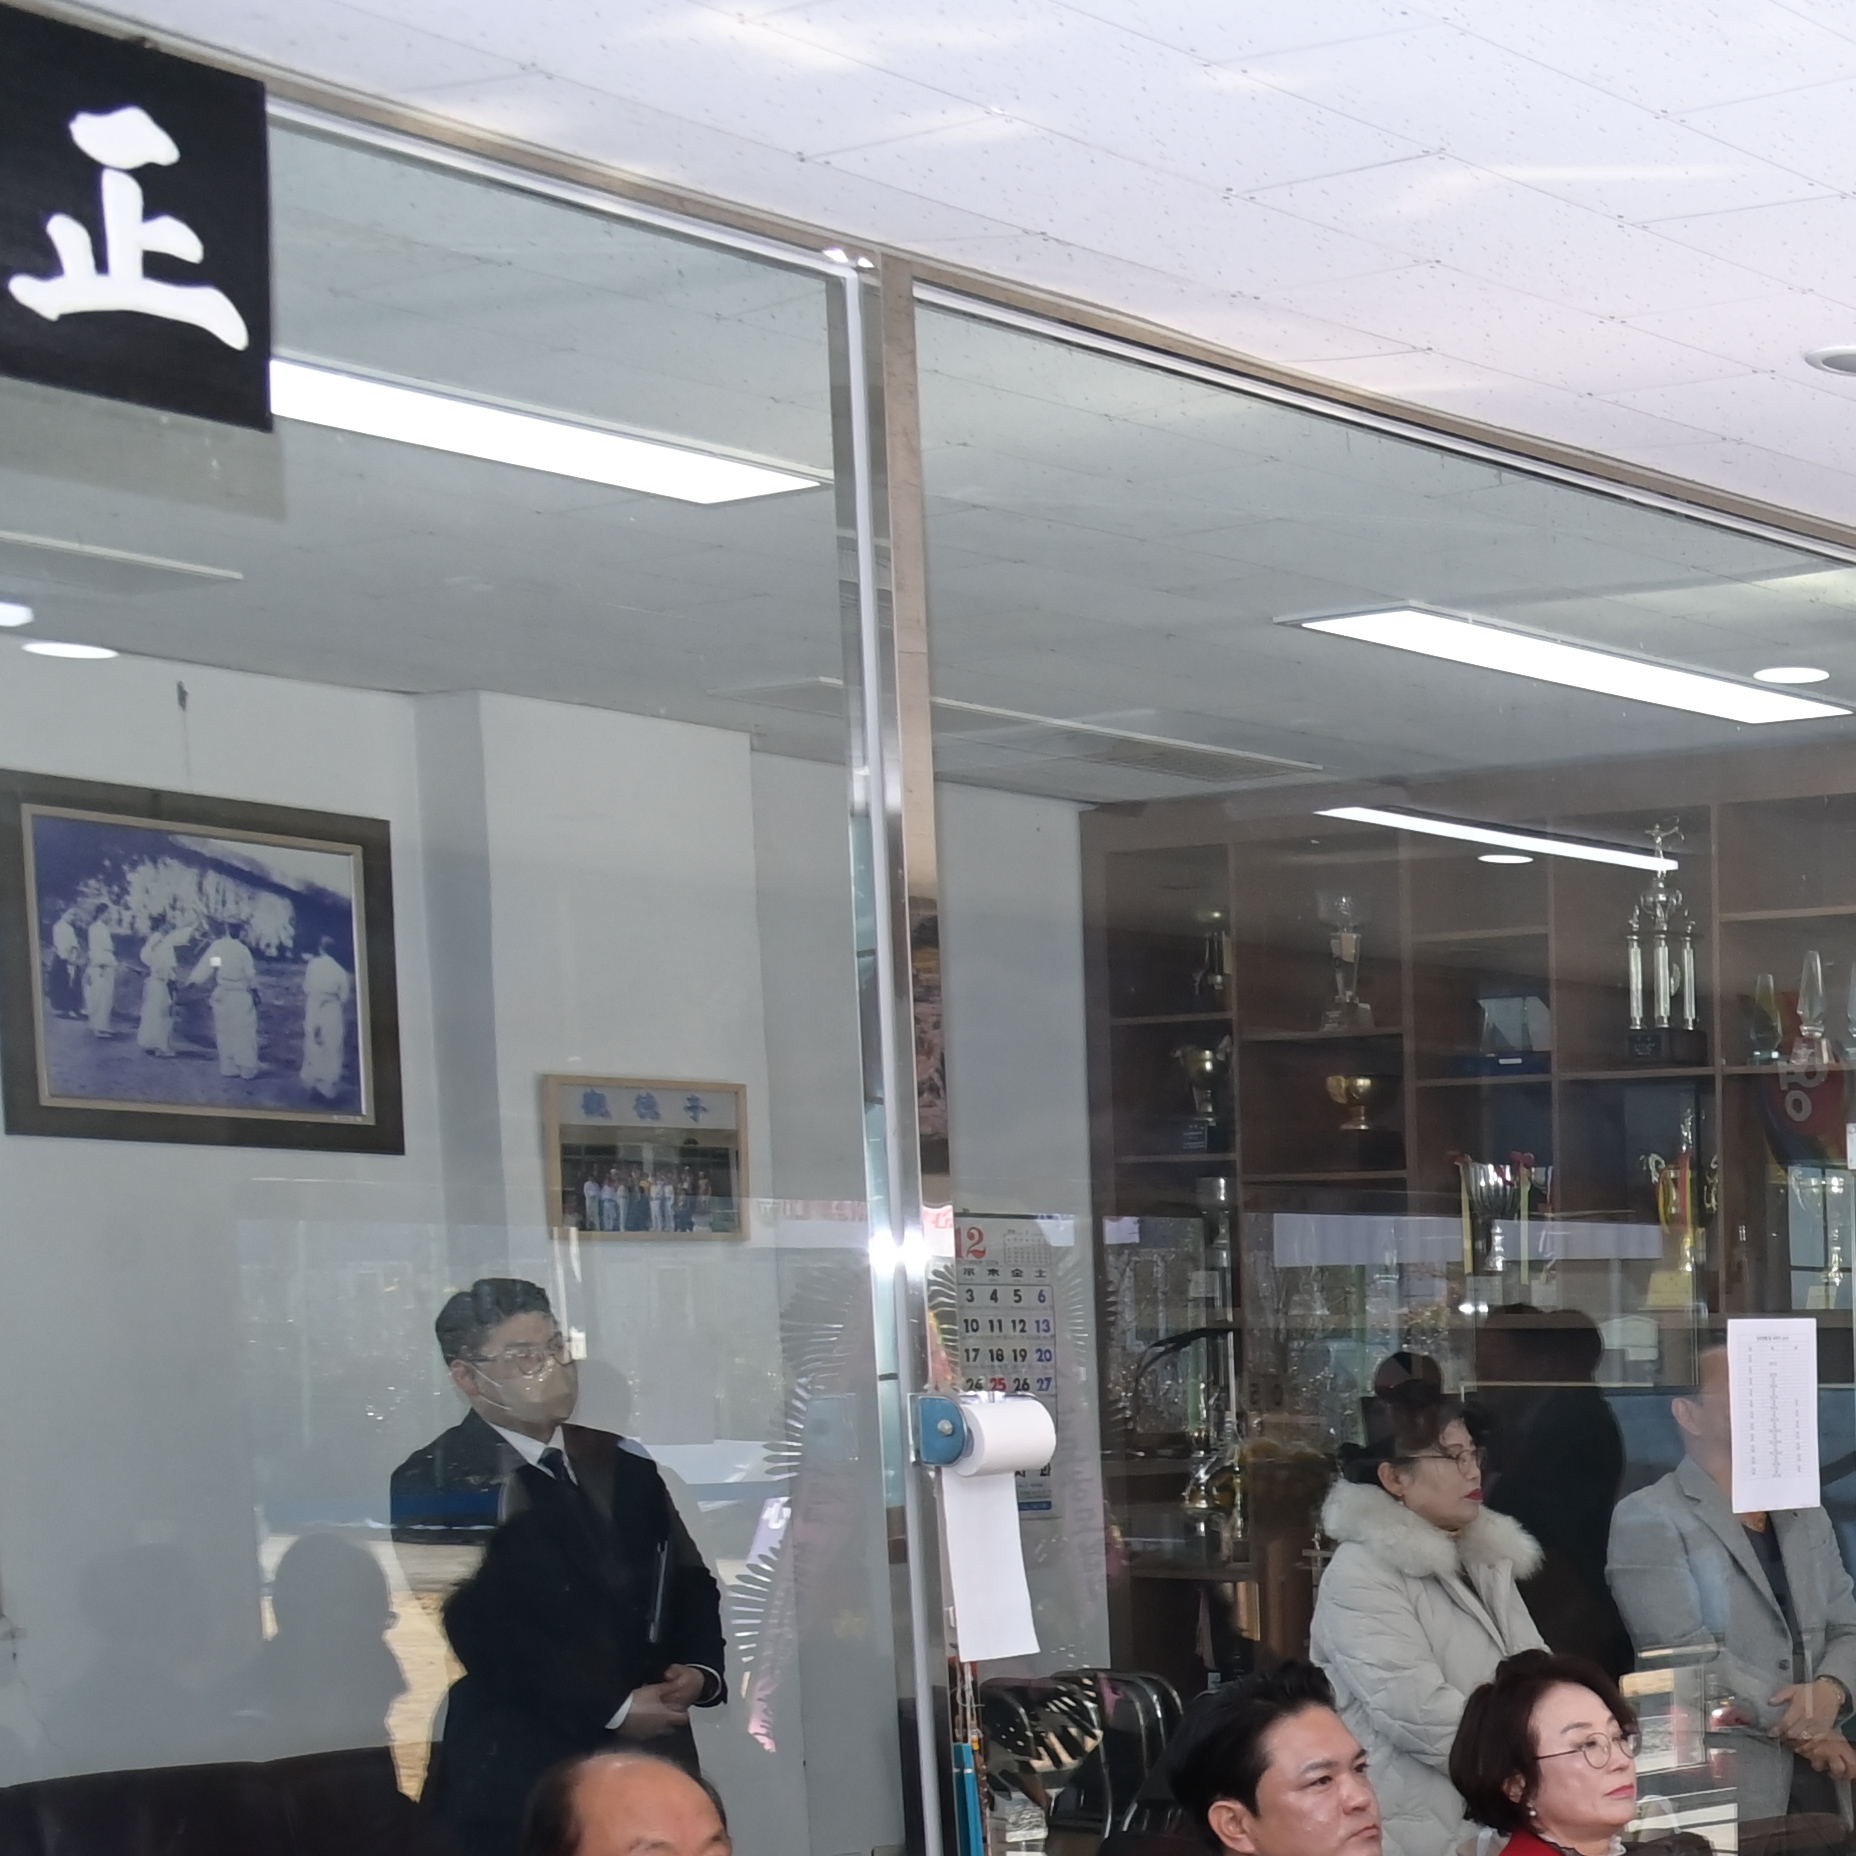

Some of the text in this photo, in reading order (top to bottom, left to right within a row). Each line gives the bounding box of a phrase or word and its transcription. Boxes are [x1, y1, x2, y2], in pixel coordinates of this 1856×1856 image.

[8, 106, 248, 351] 正
[955, 1227, 986, 1259] 12
[1034, 1269, 1047, 1278] 土
[966, 1288, 1046, 1303] 3 4 5 6
[963, 1318, 1051, 1333] 10 11 12 13
[964, 1348, 1052, 1363] 17 18 19 20
[989, 1377, 1007, 1392] 25
[1013, 1377, 1030, 1392] 26
[1036, 1377, 1052, 1392] 27
